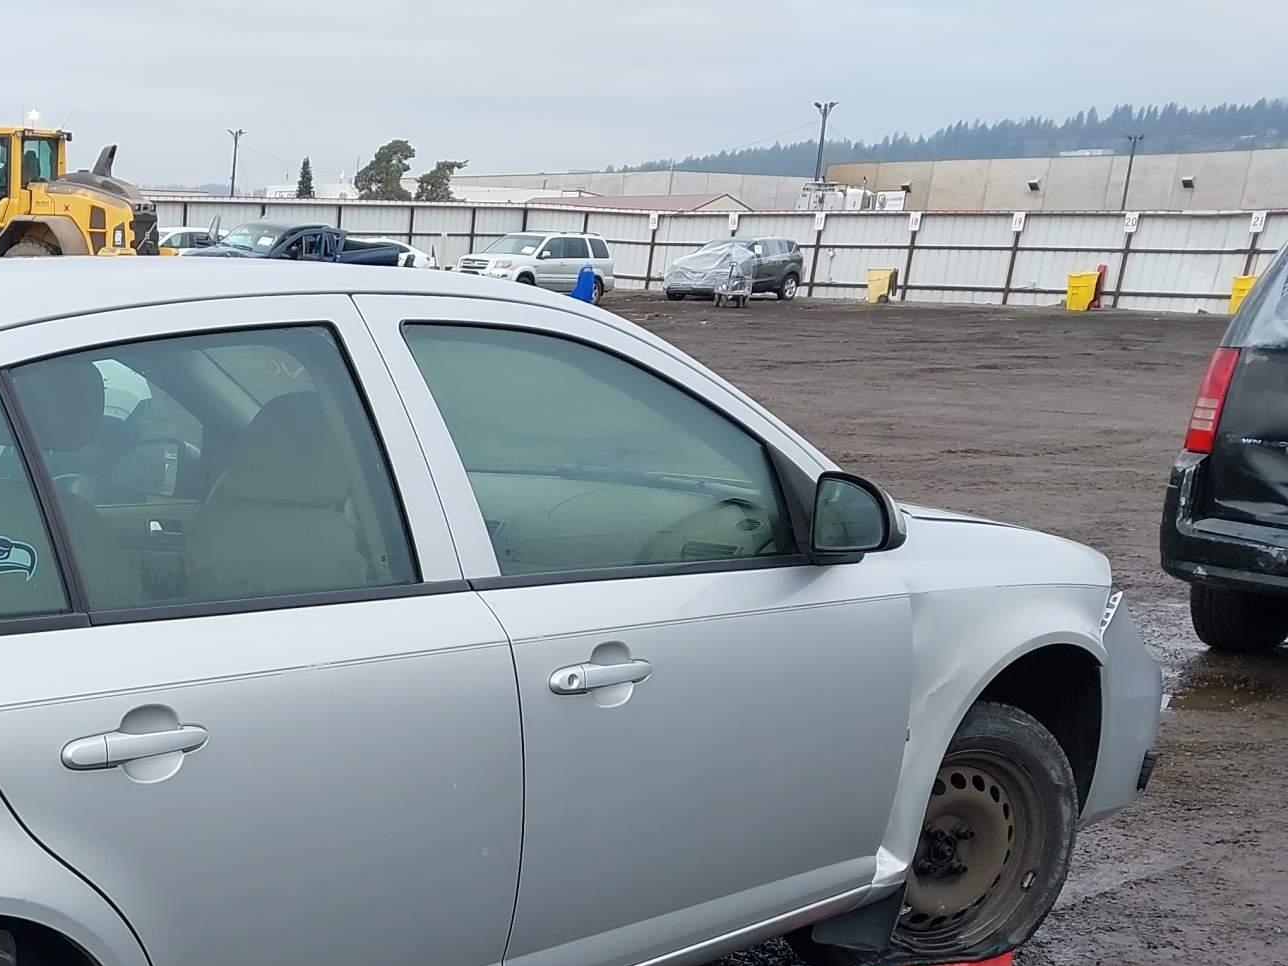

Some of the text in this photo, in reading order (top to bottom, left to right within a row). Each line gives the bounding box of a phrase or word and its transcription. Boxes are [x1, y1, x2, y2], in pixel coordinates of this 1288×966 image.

[1014, 217, 1023, 225] 19
[1125, 217, 1137, 227] 20
[1253, 216, 1264, 226] 21
